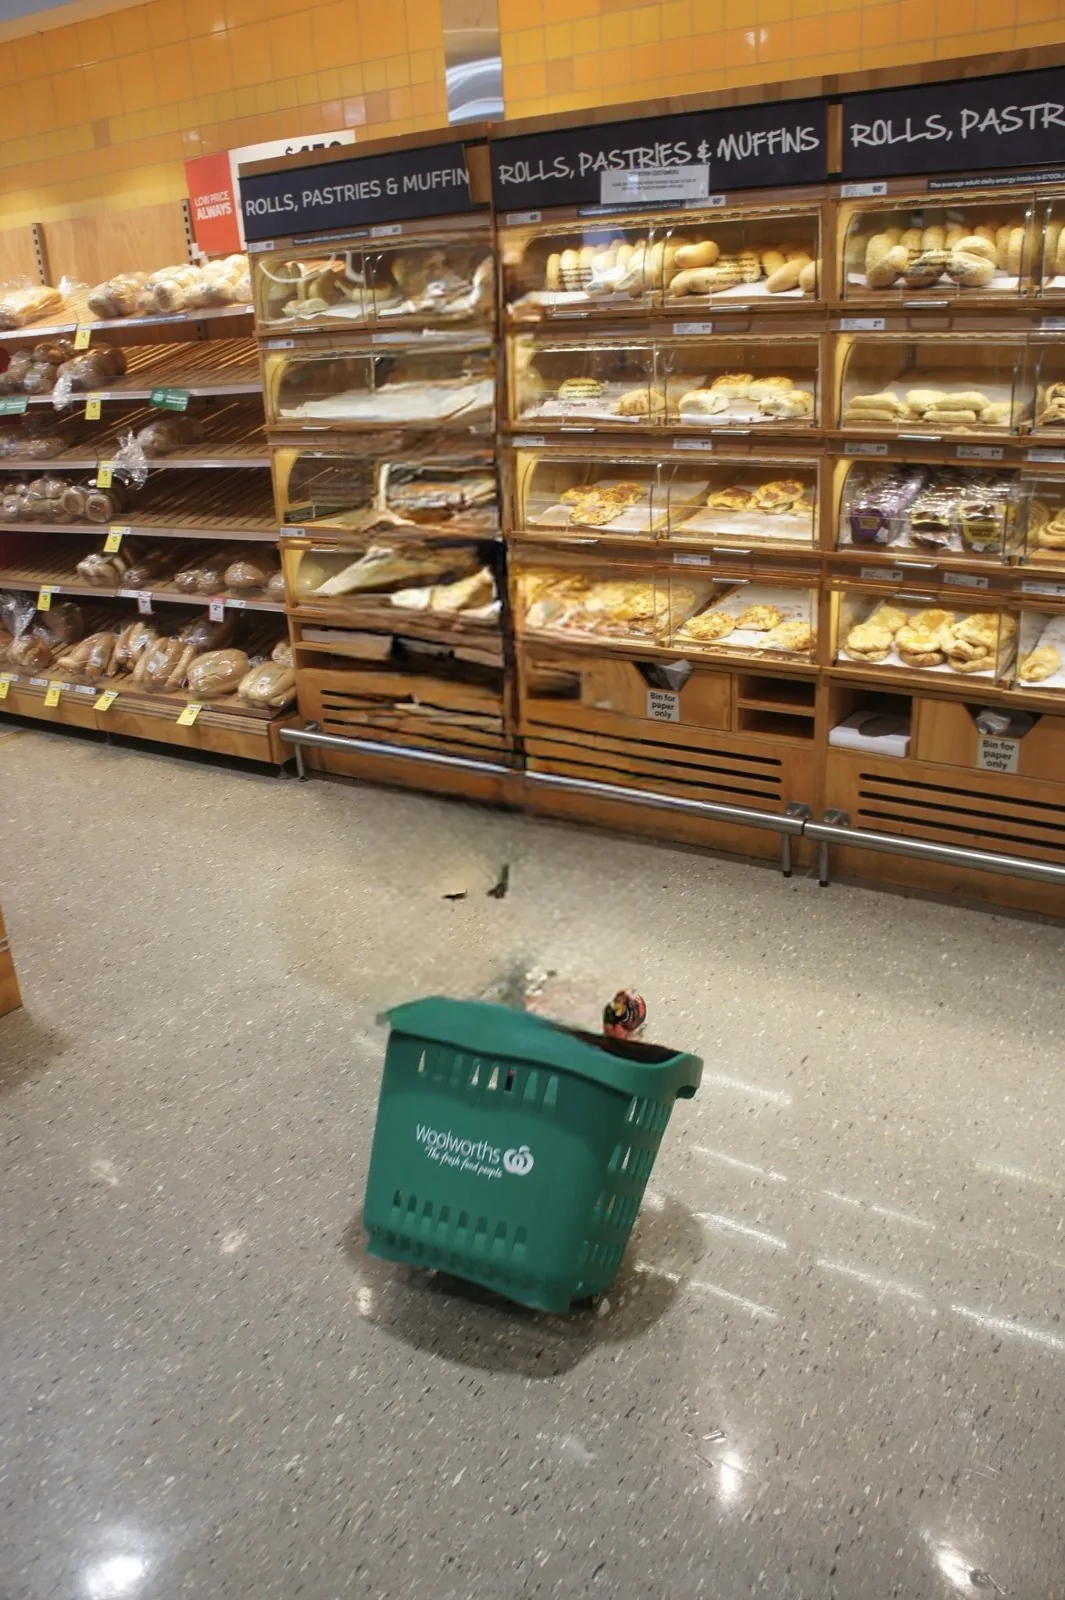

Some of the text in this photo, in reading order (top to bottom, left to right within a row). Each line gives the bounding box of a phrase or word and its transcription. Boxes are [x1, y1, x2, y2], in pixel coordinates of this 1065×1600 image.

[850, 102, 1065, 147] ROLLS, PASTR
[498, 126, 820, 184] ROLLS, PASTRIES & MUFFINS
[194, 190, 230, 207] LOW PRICE
[245, 168, 470, 216] ROLLS, PASTRIES & MUFFIN
[196, 201, 232, 220] ALWAYS
[650, 692, 676, 702] Bin for
[652, 702, 674, 710] paper
[654, 710, 672, 719] only
[983, 740, 1015, 751] Bin for
[983, 751, 1012, 760] paper
[986, 761, 1008, 770] only
[416, 1123, 501, 1165] Woolworths
[424, 1144, 503, 1180] The fresh food people
